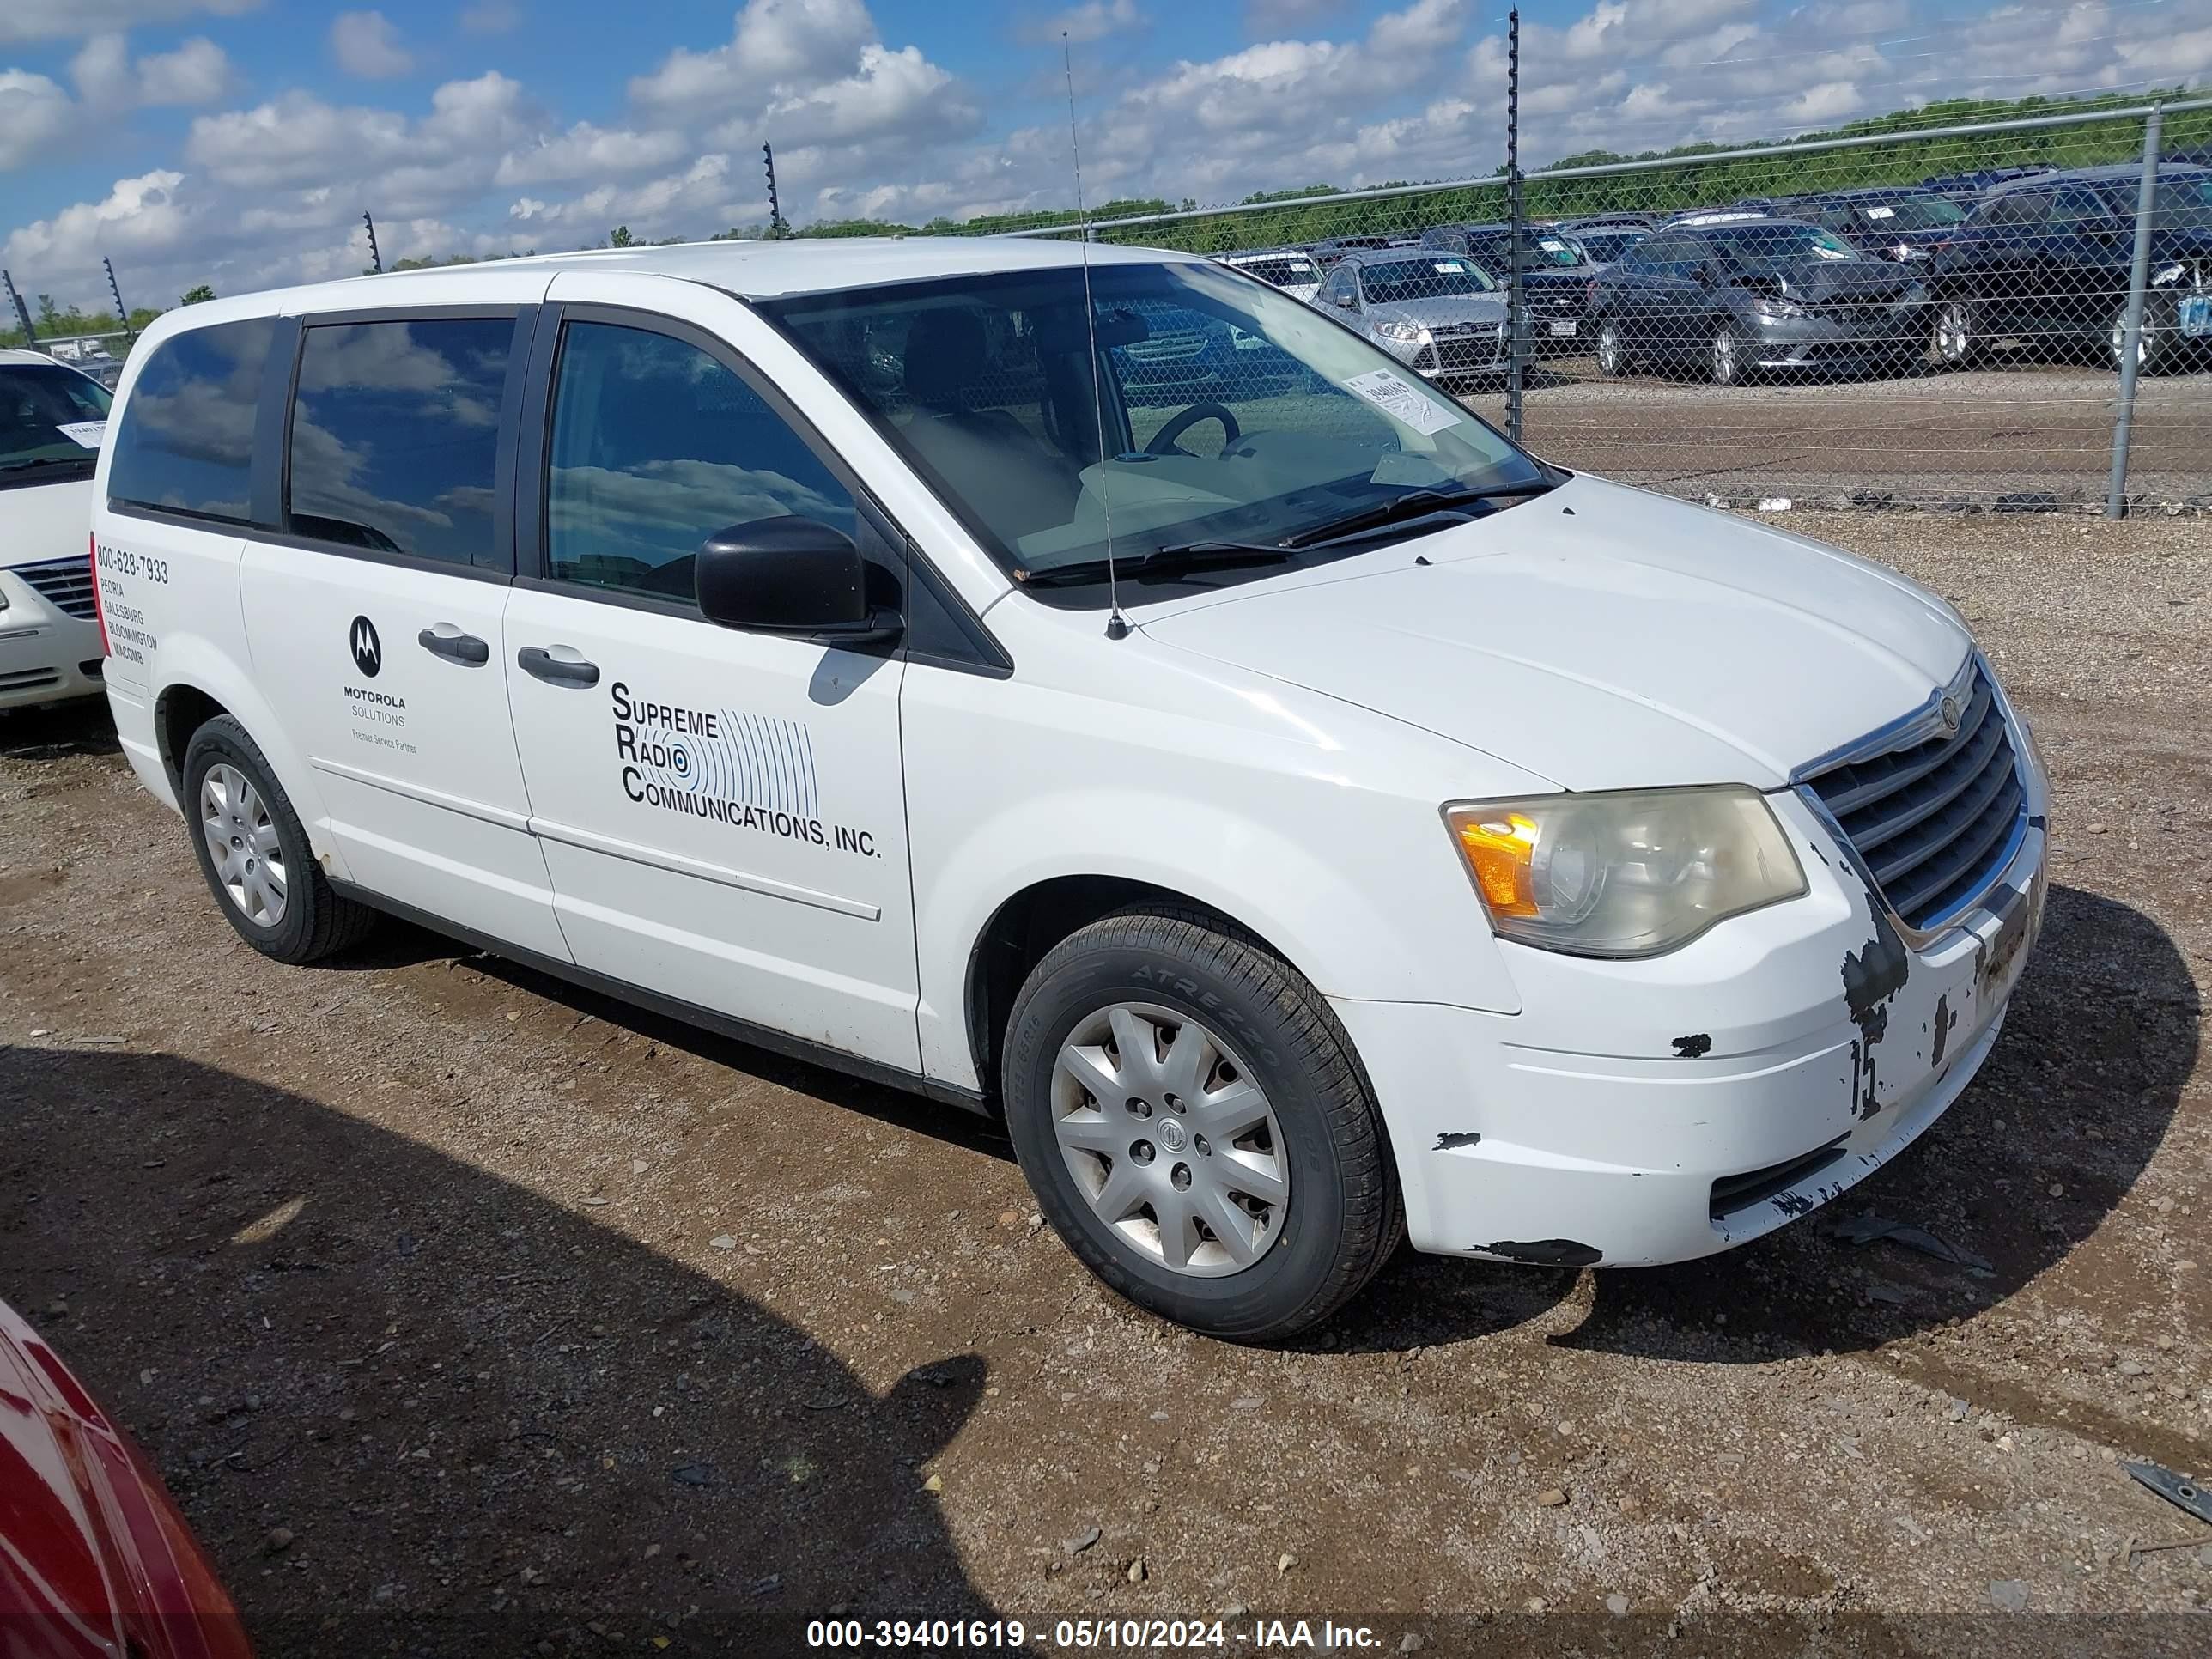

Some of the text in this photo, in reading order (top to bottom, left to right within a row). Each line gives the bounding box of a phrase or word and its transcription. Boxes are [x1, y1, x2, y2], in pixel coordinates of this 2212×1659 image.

[97, 544, 168, 585] 800-628-7933
[100, 578, 125, 598] PEORIA
[104, 600, 144, 625] GALESBURG
[108, 621, 158, 651] BLOOMINGTON
[112, 641, 144, 665] MACOMB
[343, 686, 406, 709] MOTOROLA
[611, 682, 719, 739] SUPREME
[351, 705, 405, 727] SOLUTIONS
[374, 734, 395, 749] Service
[395, 739, 416, 754] Partner
[615, 723, 688, 773] RADIO
[622, 766, 882, 859] COMMUNICATIONS, INC.
[1131, 964, 1280, 1066] ATREZZO
